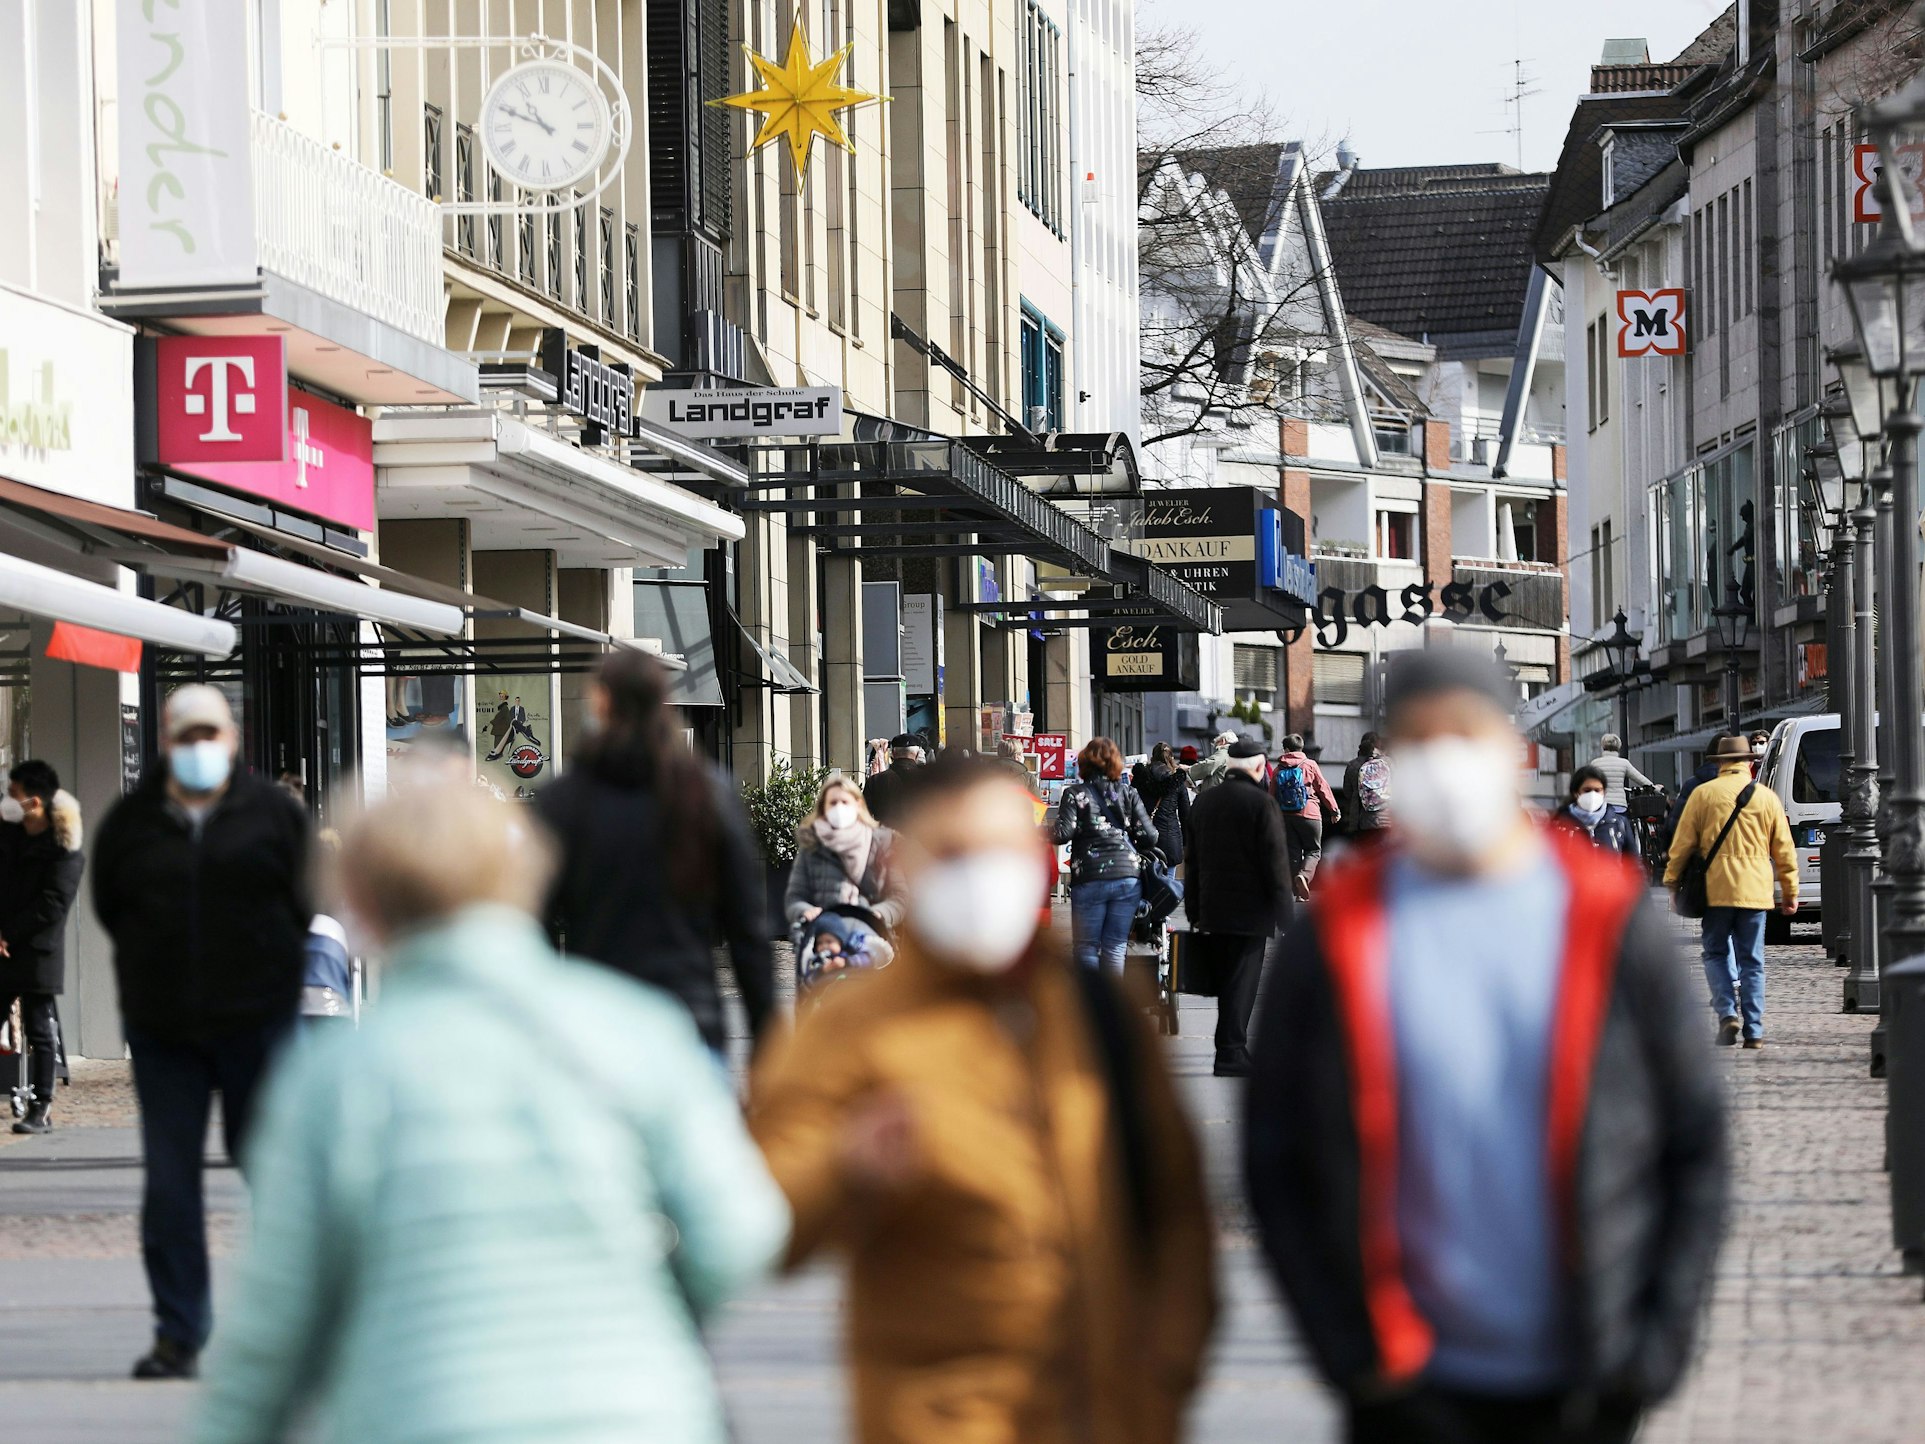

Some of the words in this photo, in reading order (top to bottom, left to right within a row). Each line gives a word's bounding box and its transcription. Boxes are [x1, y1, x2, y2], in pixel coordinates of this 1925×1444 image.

[1633, 308, 1668, 337] M
[716, 390, 743, 398] Haus
[745, 389, 762, 397] der
[766, 388, 805, 396] Schuhe
[669, 396, 830, 427] Landgraf
[1126, 508, 1173, 531] Jakob
[1173, 506, 1213, 526] Esch
[1184, 567, 1229, 578] UHREN
[1112, 607, 1155, 615] JUWELIER
[1277, 578, 1512, 648] gasse
[1107, 625, 1162, 650] Esch
[1121, 655, 1148, 664] GOLD
[1115, 664, 1155, 674] ANKAUF
[1037, 737, 1063, 748] SALE
